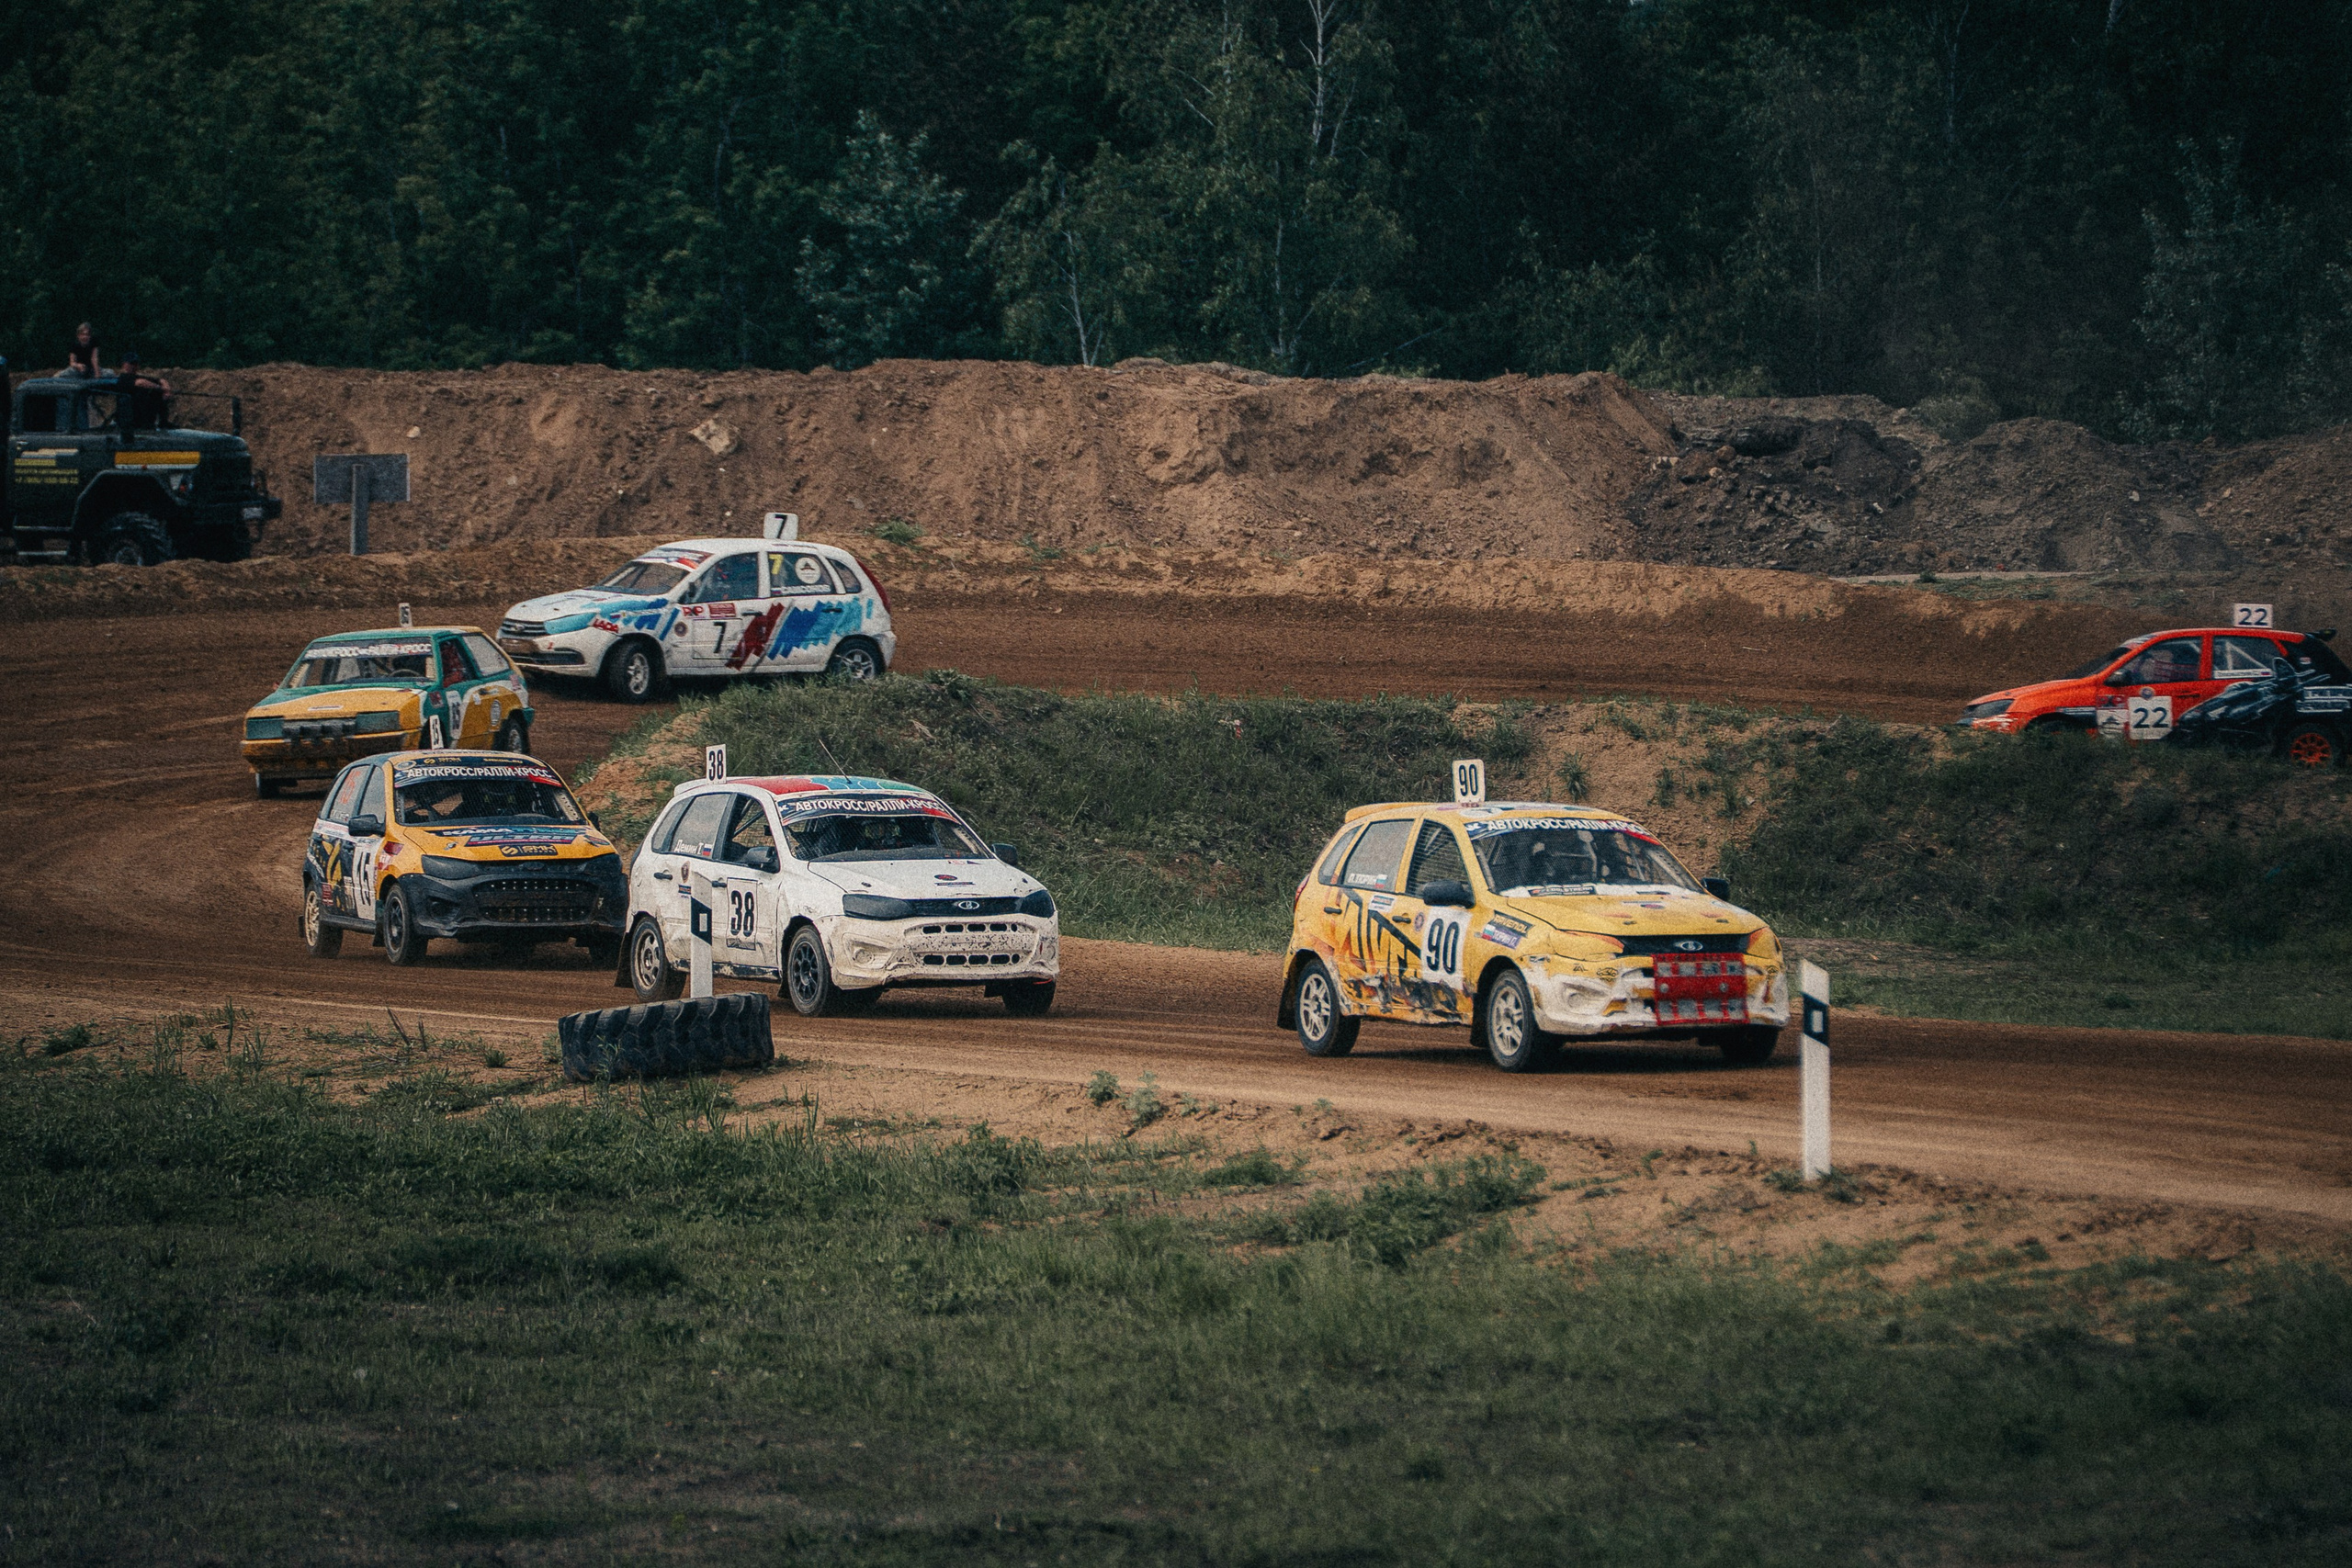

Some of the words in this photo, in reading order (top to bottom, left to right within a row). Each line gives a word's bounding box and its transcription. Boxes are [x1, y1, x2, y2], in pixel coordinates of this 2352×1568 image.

[775, 513, 788, 539] 7
[769, 553, 784, 575] 7
[2238, 607, 2268, 626] 22
[713, 621, 728, 654] 7
[2132, 706, 2169, 728] 22
[708, 749, 724, 781] 38
[1459, 763, 1478, 796] 90
[730, 890, 755, 938] 38
[1426, 918, 1459, 976] 90
